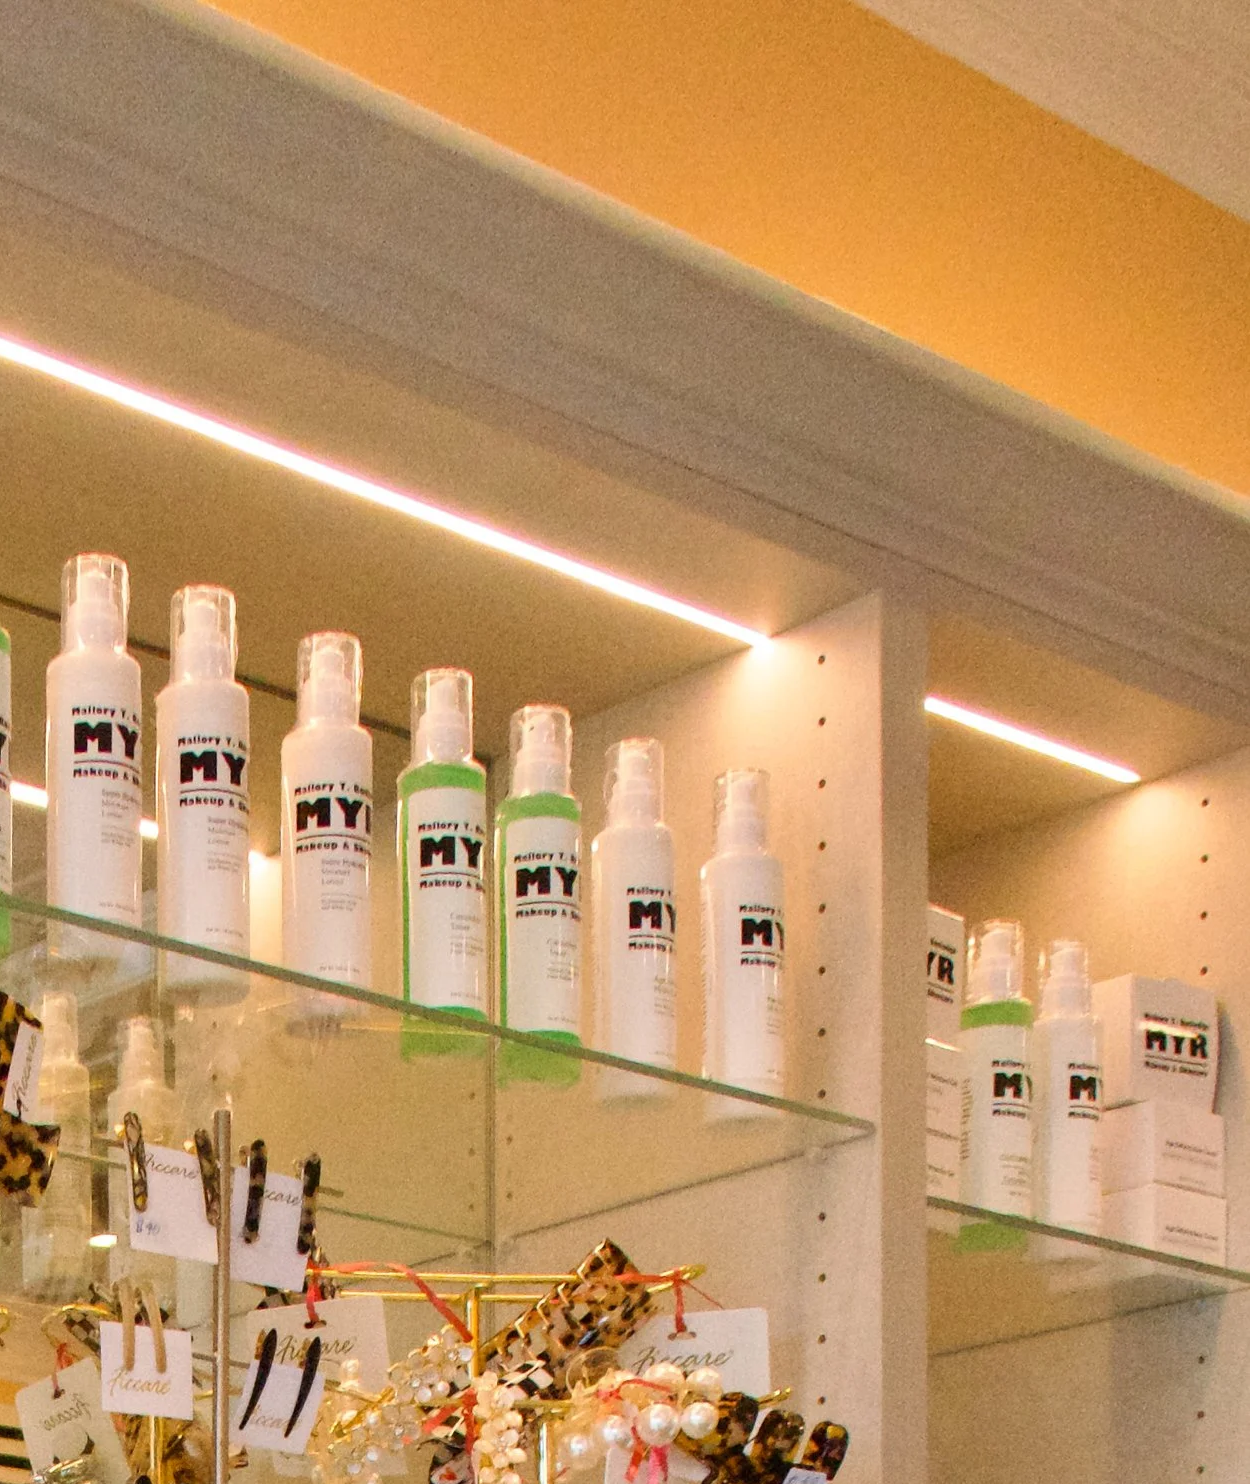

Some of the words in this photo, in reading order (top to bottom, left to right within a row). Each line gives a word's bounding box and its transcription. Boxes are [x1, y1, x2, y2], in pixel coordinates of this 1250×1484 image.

[72, 705, 116, 717] Mallory
[177, 735, 220, 747] Mallory
[73, 768, 119, 780] Makeup
[295, 782, 335, 796] Mallory
[339, 783, 350, 792] Y.
[179, 797, 224, 809] Makeup
[418, 821, 459, 833] Mallory
[296, 842, 338, 854] Makeup
[343, 842, 350, 850] &
[514, 852, 553, 864] Mallory
[420, 879, 462, 890] Makeup
[627, 887, 664, 897] Mallory
[516, 908, 557, 919] Makeup
[739, 904, 776, 914] Mallory
[628, 942, 666, 952] Makeup
[276, 1334, 353, 1364] Fiare
